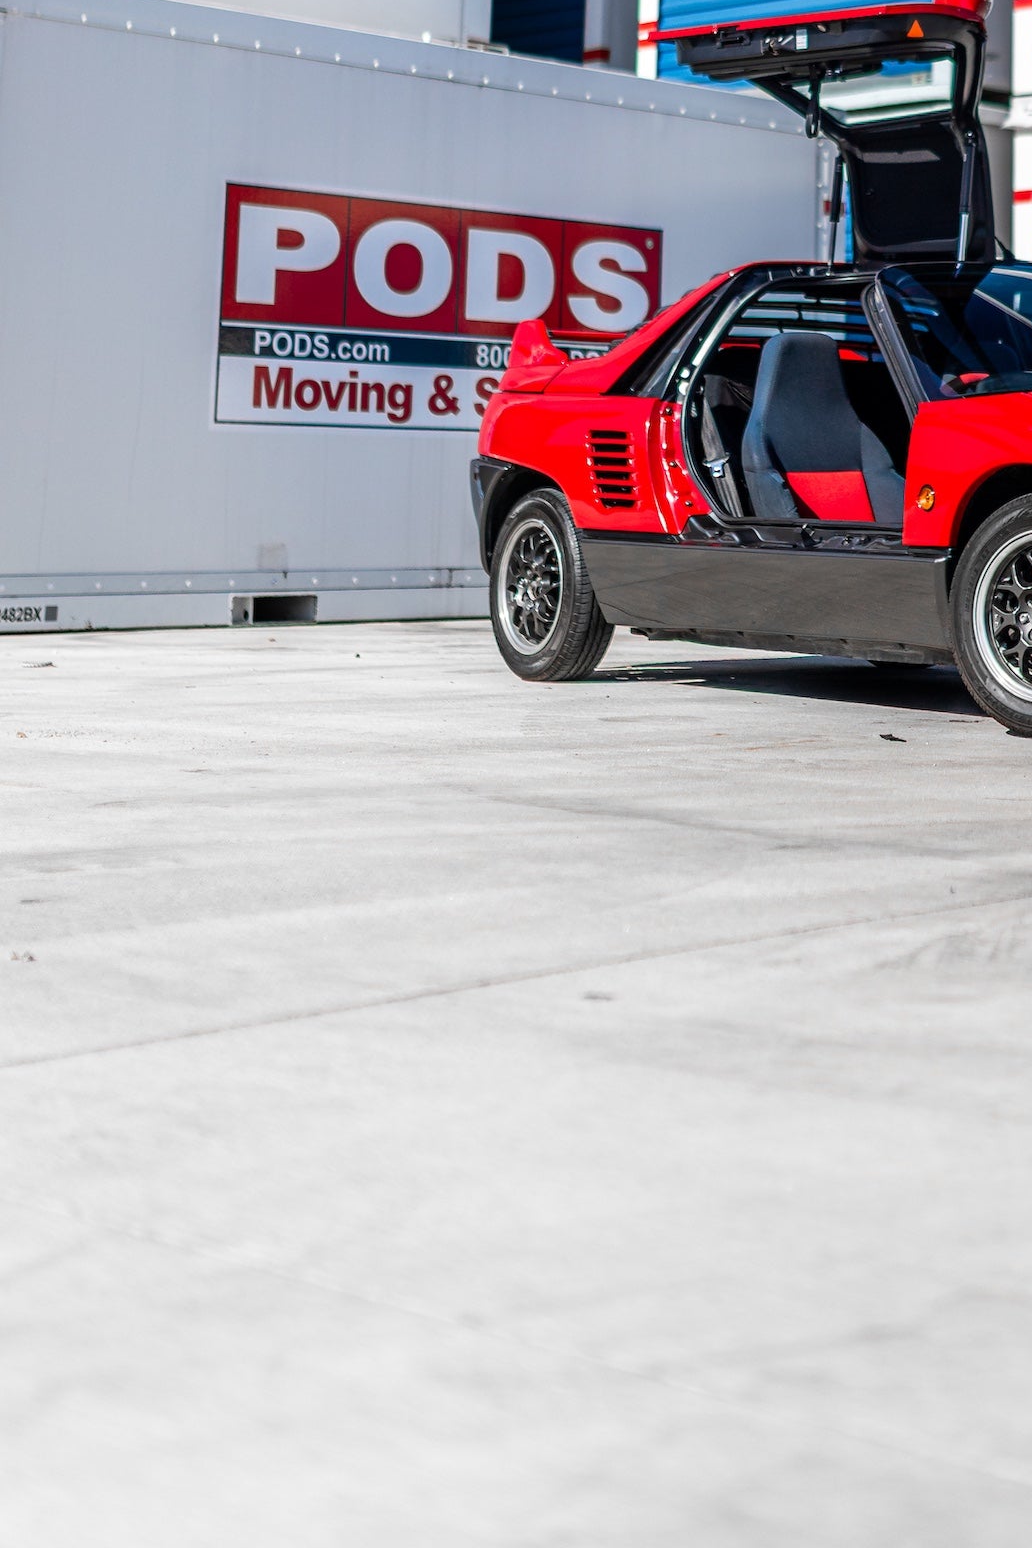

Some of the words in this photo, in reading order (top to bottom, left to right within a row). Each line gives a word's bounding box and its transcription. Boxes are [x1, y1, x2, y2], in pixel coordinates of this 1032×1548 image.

[236, 202, 650, 333] PODS
[254, 330, 390, 362] PODS.com
[253, 366, 413, 423] Moving
[428, 375, 460, 416] &
[0, 607, 42, 622] 482BX
